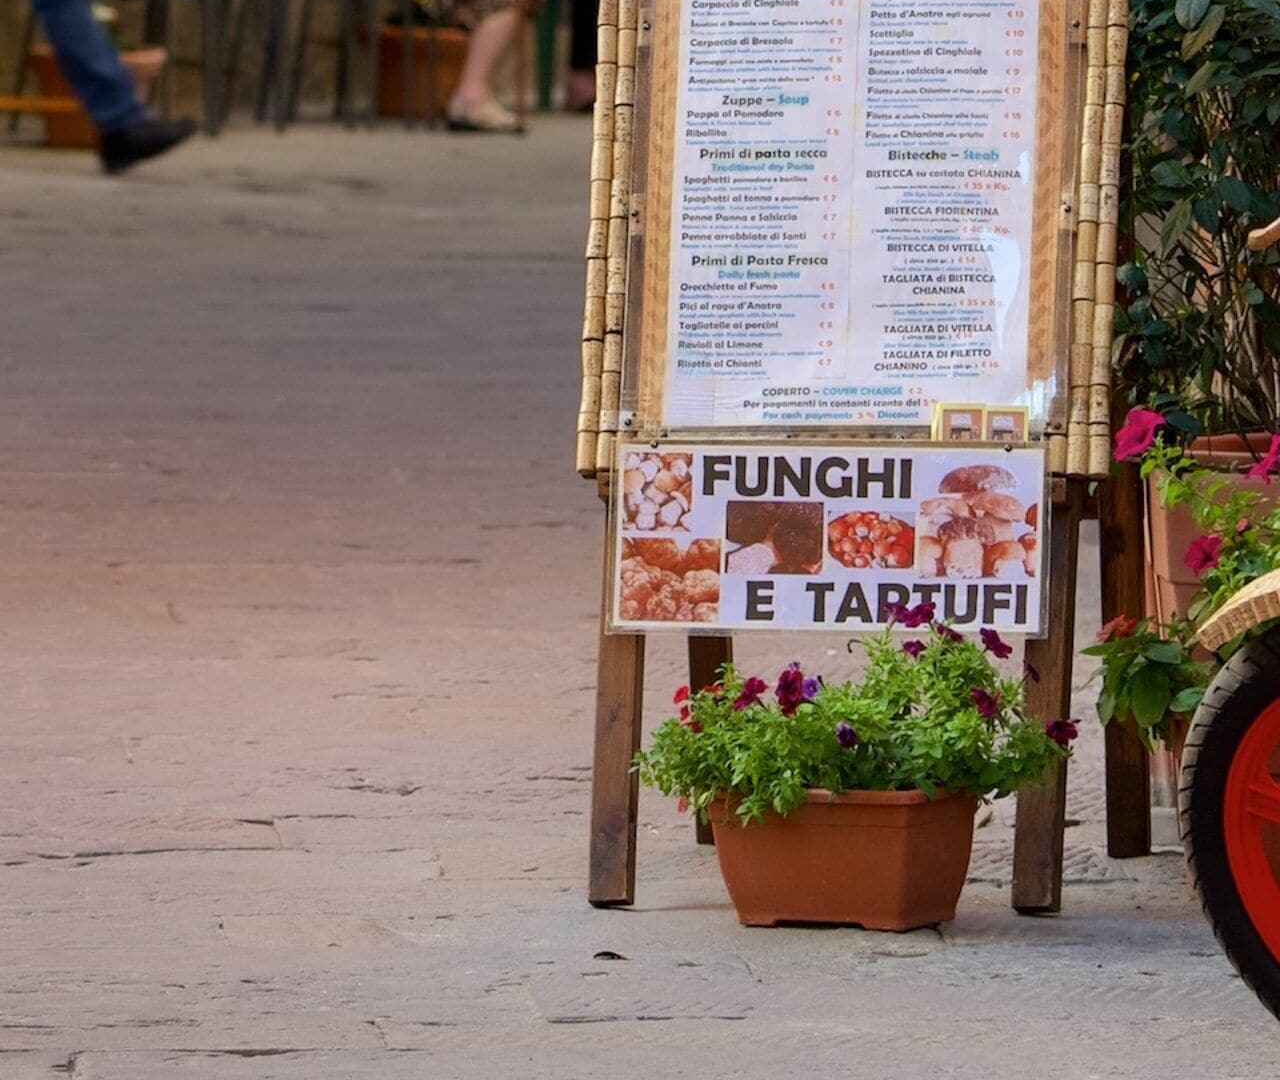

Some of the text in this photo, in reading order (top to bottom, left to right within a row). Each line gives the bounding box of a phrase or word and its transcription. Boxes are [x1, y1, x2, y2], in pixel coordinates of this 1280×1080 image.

[692, 0, 799, 9] Carpaccio di Cinghiale
[936, 48, 982, 57] Cinghiale
[722, 95, 809, 107] Zuppe Soup
[700, 149, 827, 160] Primi di pasta secca
[888, 150, 947, 160] Bistecche
[866, 170, 913, 178] BISTECCA
[968, 169, 1021, 178] CHIANINA
[884, 207, 999, 216] BISTECCA FIORENTINA
[887, 244, 994, 252] BISTECCA DI VITELLA
[692, 255, 828, 266] Primi di Pasta Fresca
[718, 271, 744, 279] Daily
[747, 271, 771, 279] fresh
[883, 275, 933, 283] TAGLIATA
[949, 274, 996, 283] BISTECCA
[913, 287, 965, 295] CHIANINA
[679, 322, 730, 331] Tagliatelle
[745, 322, 778, 330] porcini
[884, 324, 993, 333] TAGLIATA DI VITELLA
[678, 341, 712, 349] Ravioli
[727, 340, 763, 348] Limone
[883, 349, 991, 359] TAGLIATA DI FILETTO
[678, 360, 712, 368] Risotto
[726, 359, 761, 368] Chianti
[874, 363, 927, 371] CHIANINO
[762, 388, 810, 396] COPERTO
[823, 387, 857, 396] COVER
[861, 387, 903, 395] CHARGE
[744, 400, 760, 408] Per
[763, 400, 816, 409] pagamenti
[906, 399, 921, 407] del
[763, 412, 778, 420] For
[782, 411, 802, 419] cash
[806, 412, 852, 420] payments
[878, 411, 918, 419] Discount
[702, 454, 913, 499] FUNGHI
[745, 580, 1028, 625] E TARTUFI
